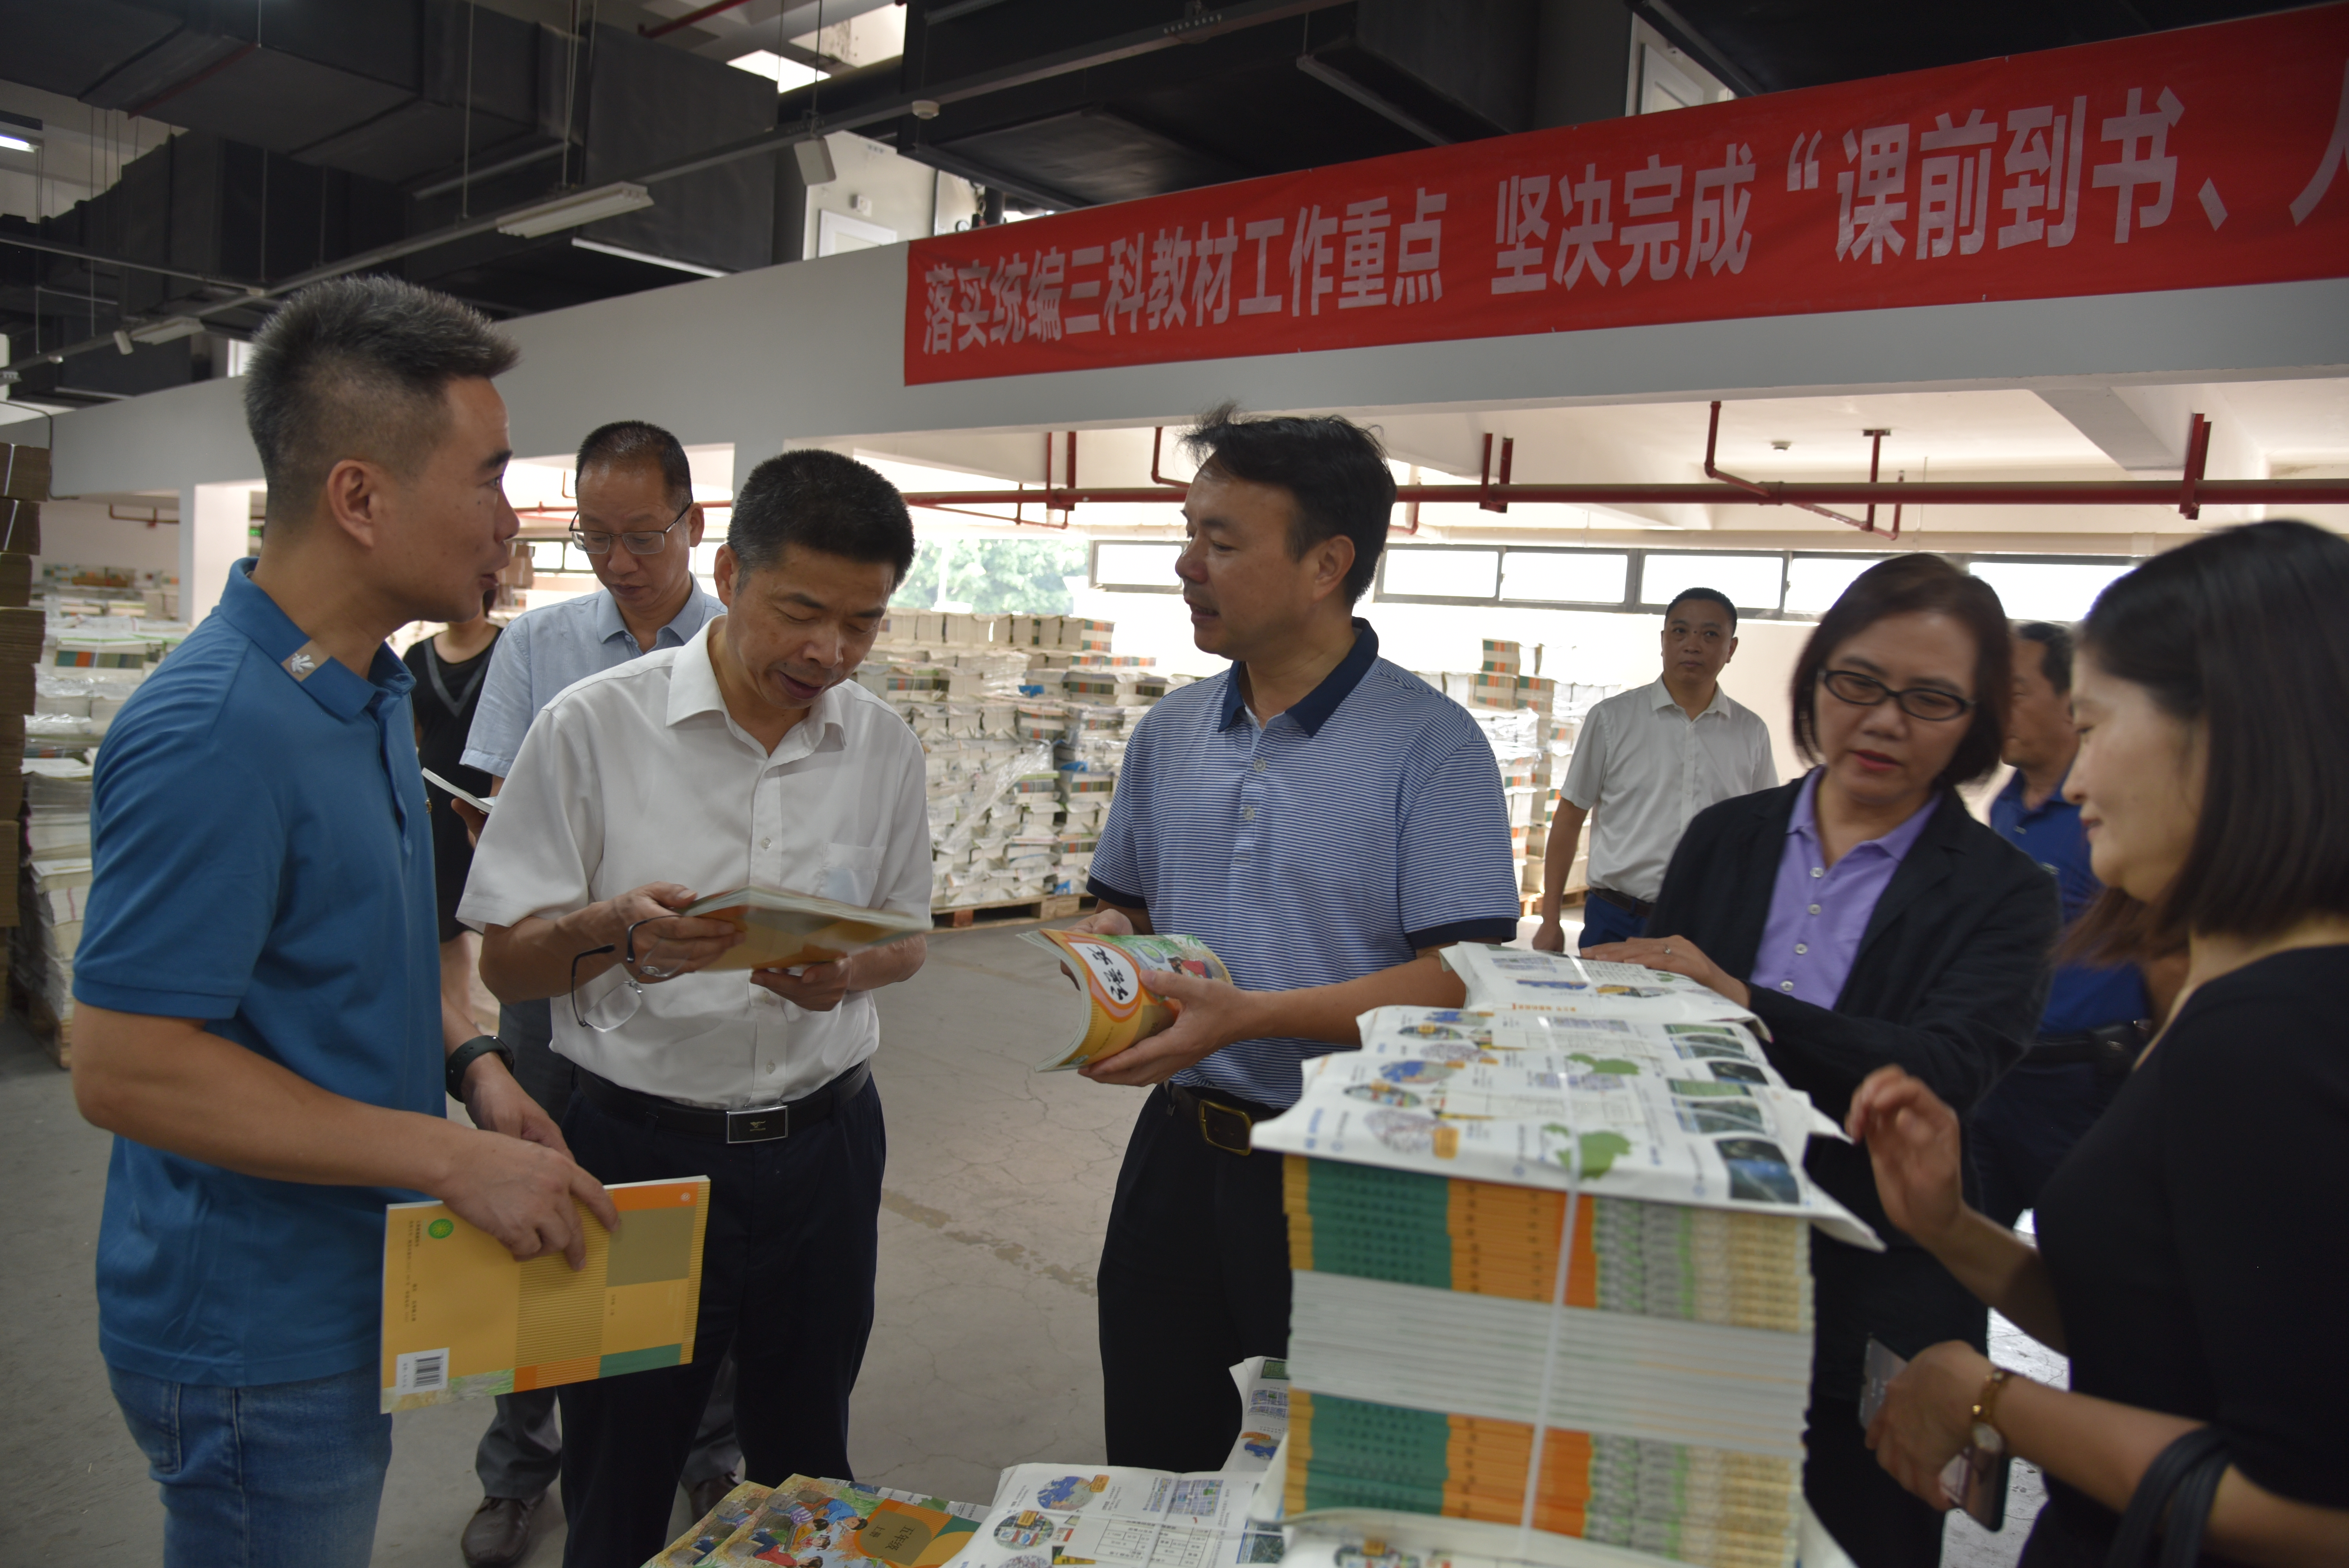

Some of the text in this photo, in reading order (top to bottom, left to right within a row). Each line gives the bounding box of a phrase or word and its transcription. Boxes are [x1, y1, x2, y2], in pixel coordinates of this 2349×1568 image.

[922, 188, 1447, 355] 落实统编三科教材工作重点
[1087, 945, 1129, 1000] 语文
[869, 1524, 886, 1538] 上册
[885, 1525, 916, 1551] 五年级
